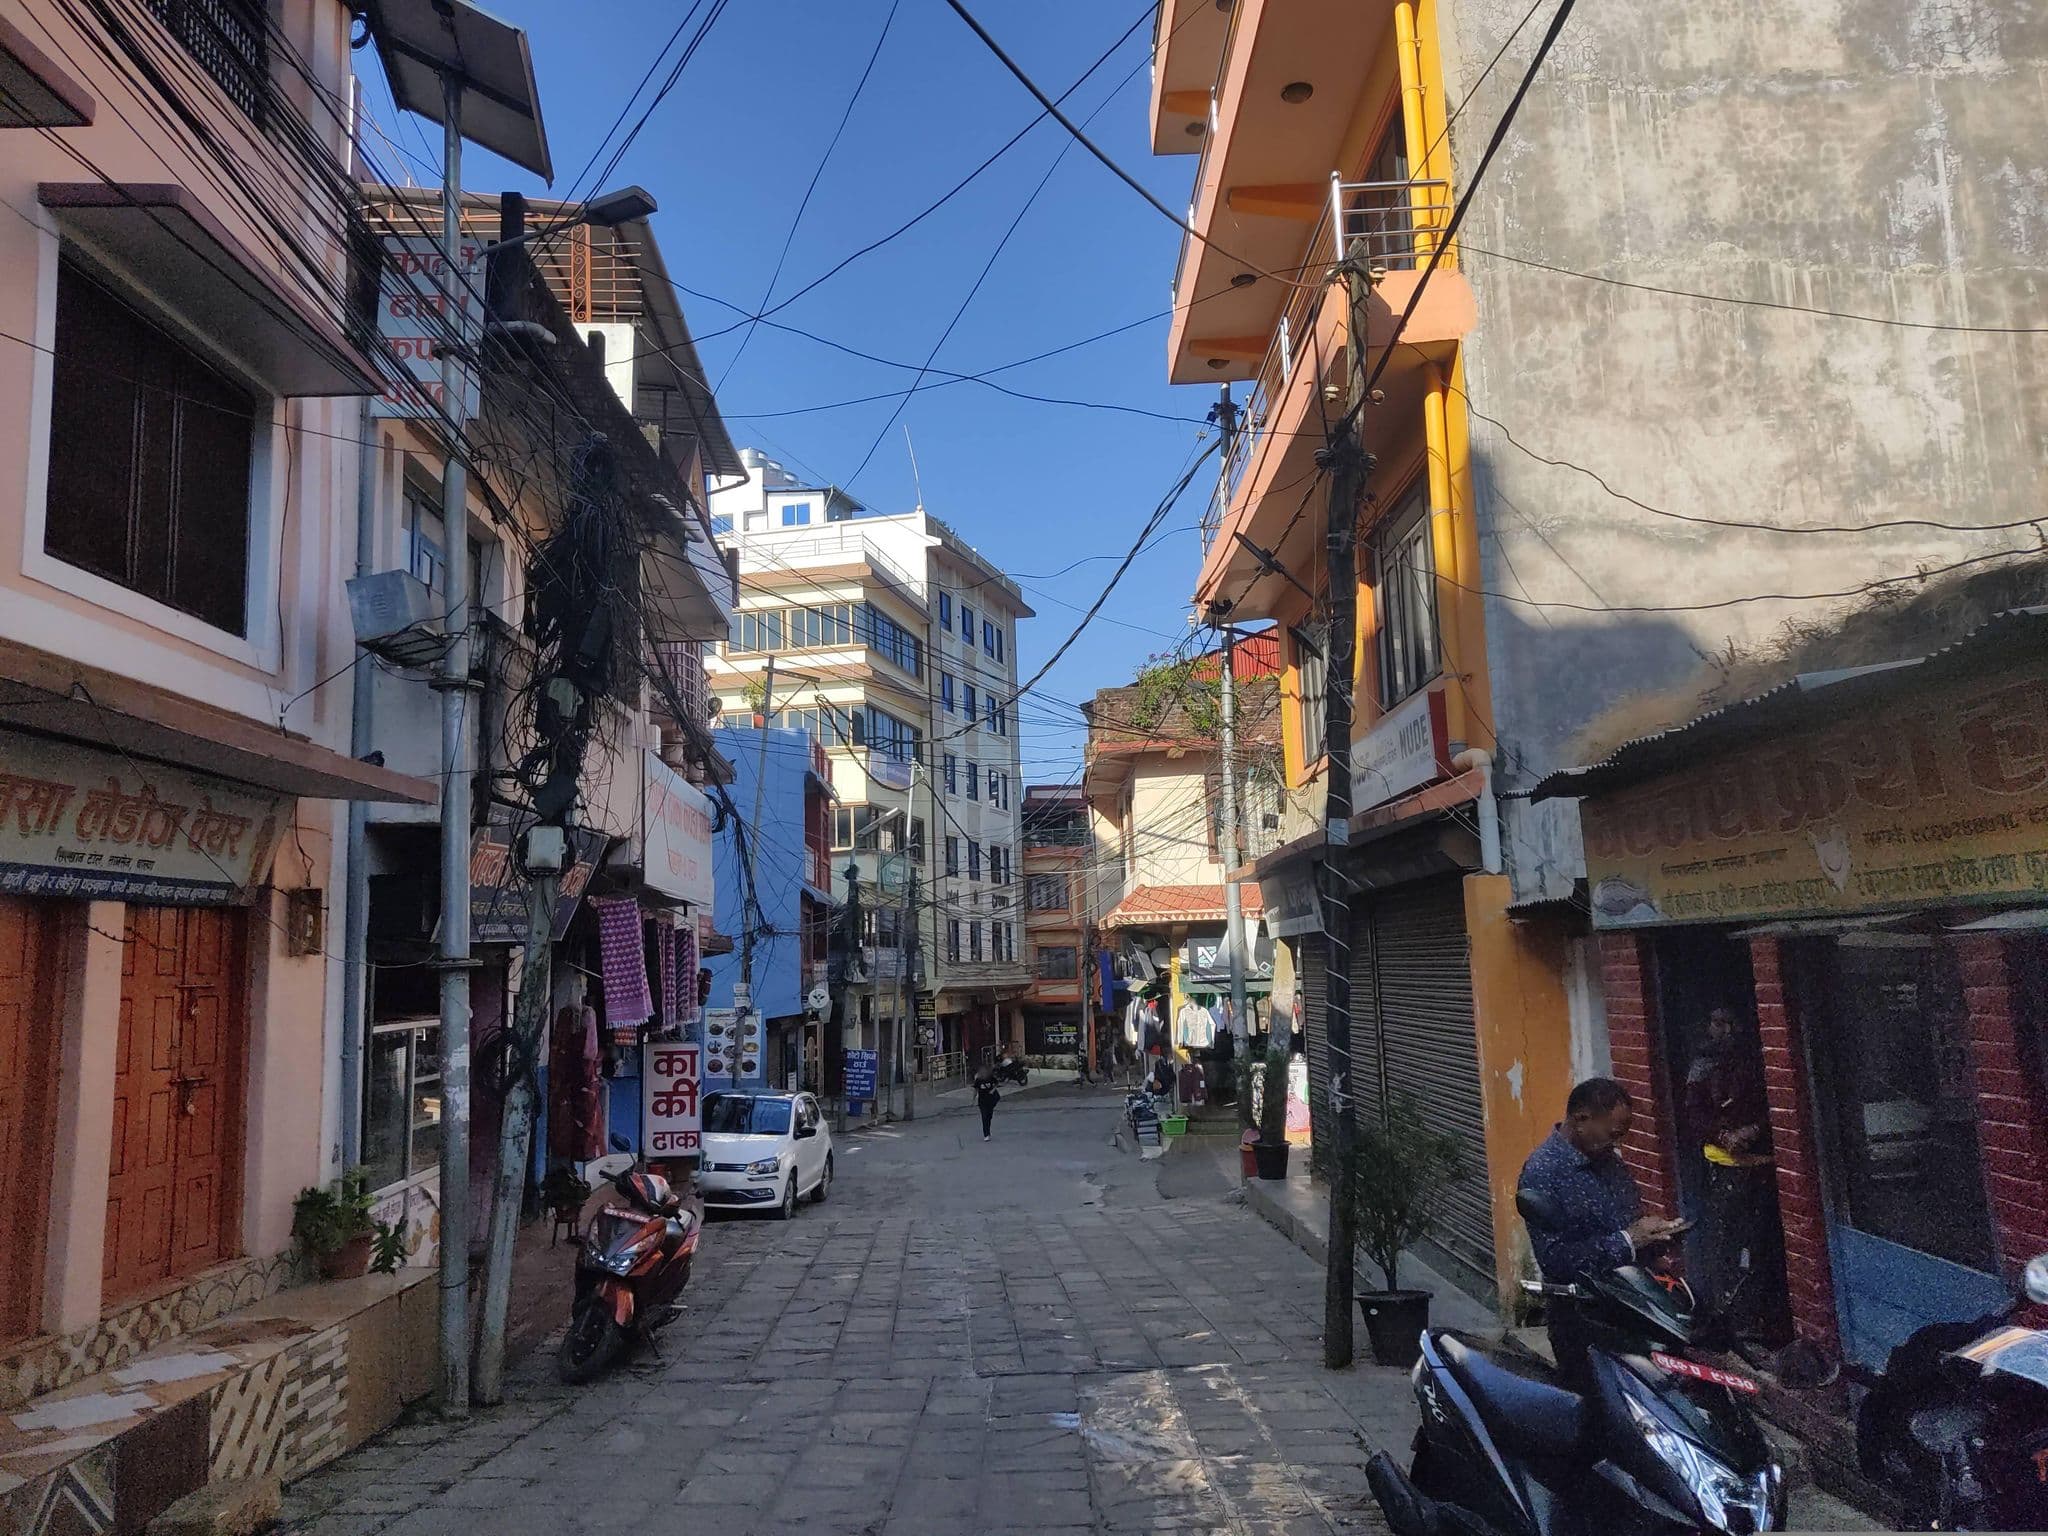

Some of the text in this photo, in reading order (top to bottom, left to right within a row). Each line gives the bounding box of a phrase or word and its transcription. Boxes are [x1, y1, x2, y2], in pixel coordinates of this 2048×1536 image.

[1399, 714, 1429, 760] NUDE
[653, 1050, 699, 1077] का
[652, 1130, 701, 1151] ढाका
